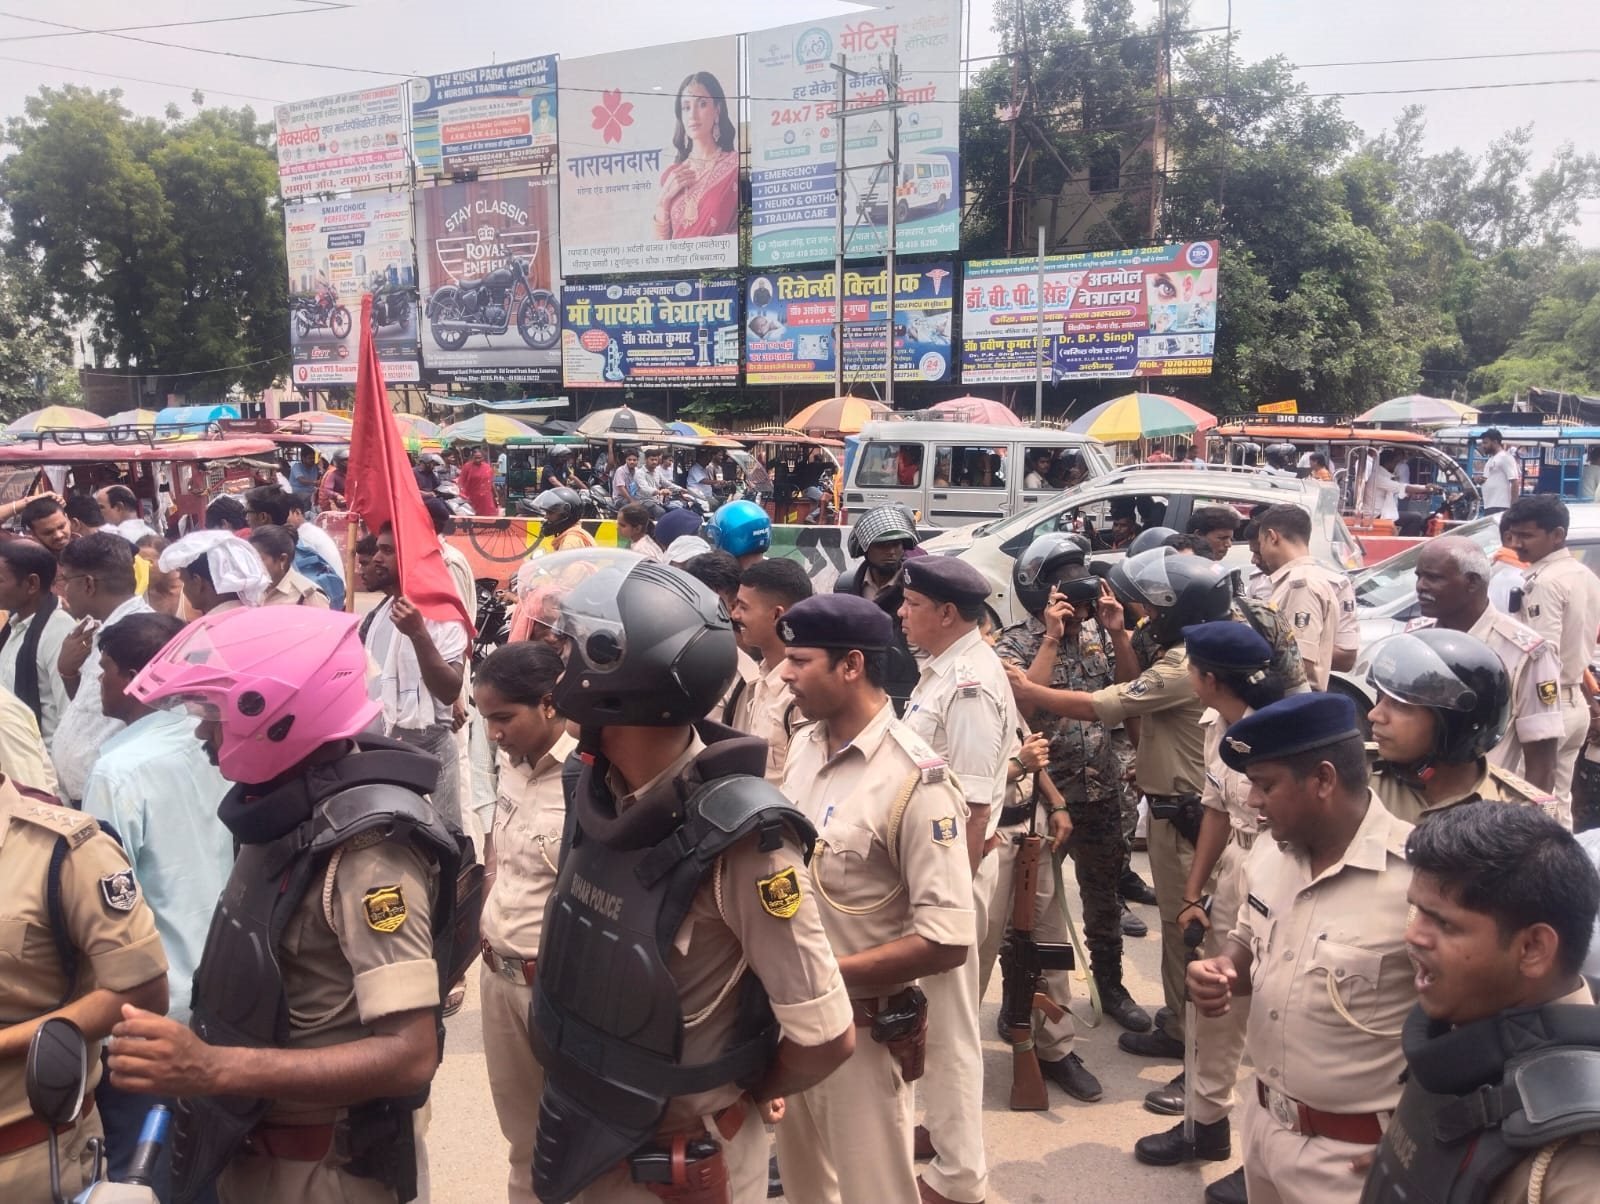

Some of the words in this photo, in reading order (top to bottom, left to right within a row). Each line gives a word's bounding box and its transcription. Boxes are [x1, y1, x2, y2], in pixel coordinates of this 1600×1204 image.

[840, 21, 899, 53] मेटिस
[434, 75, 451, 89] LAV
[453, 70, 478, 84] KUSH
[479, 67, 505, 82] PARA
[507, 58, 549, 77] MEDICAL
[444, 87, 473, 99] NURSING
[771, 104, 812, 126] 24x7
[566, 149, 663, 178] नारायनदास
[764, 166, 817, 181] EMERGENCY
[764, 184, 779, 195] ICU
[781, 183, 788, 193] &
[790, 180, 812, 192] NICU
[321, 205, 342, 215] SMART
[344, 201, 367, 212] CHOICE
[765, 196, 794, 209] NEURO
[796, 195, 803, 206] &
[805, 193, 838, 205] ORTHO
[444, 203, 473, 232] STAY
[475, 199, 529, 226] CLASSIC
[765, 211, 802, 224] TRAUMA
[804, 208, 829, 220] CARE
[465, 242, 508, 260] ROYAL
[1088, 268, 1144, 287] अनमोल
[988, 283, 1012, 309] बी.
[1012, 282, 1037, 308] पी.
[1078, 287, 1144, 307] नेत्रालय
[567, 297, 592, 326] माँ
[594, 296, 655, 326] गायत्री
[657, 295, 734, 325] नेत्रालय
[637, 329, 664, 346] सरोज
[665, 330, 692, 349] कुमार
[979, 337, 1005, 351] प्रवीण
[1006, 338, 1031, 353] कुमार
[1059, 335, 1075, 345] Dr.
[1078, 333, 1100, 344] B.P.
[1103, 331, 1135, 343] Singh
[1277, 415, 1295, 423] BIG
[1298, 415, 1325, 424] BOSS
[589, 886, 625, 921] POLICE
